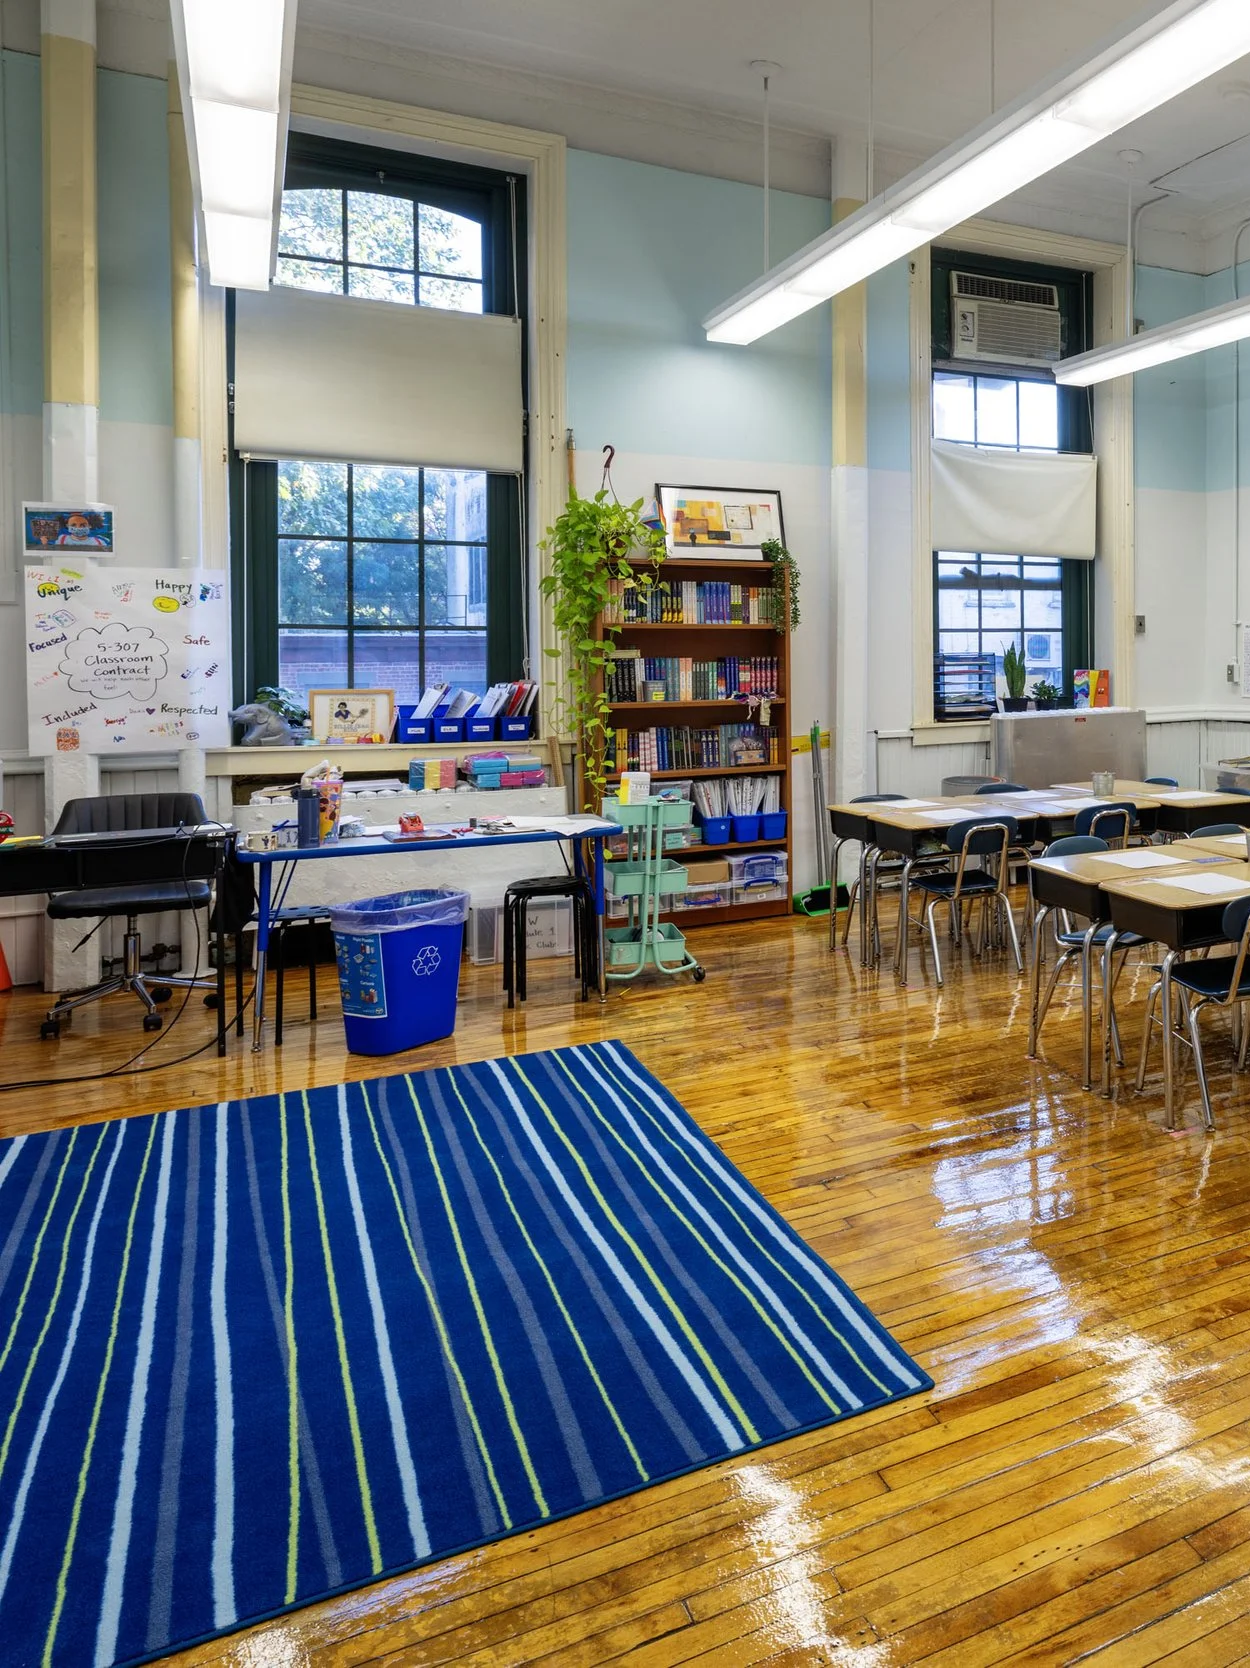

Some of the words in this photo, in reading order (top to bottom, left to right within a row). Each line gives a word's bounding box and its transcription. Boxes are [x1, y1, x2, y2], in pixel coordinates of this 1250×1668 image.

[38, 584, 83, 600] Unique
[156, 580, 192, 594] Happy
[28, 632, 68, 652] Focused
[97, 642, 140, 652] 5-307
[182, 634, 211, 646] Safe
[84, 655, 154, 666] Classroom
[41, 702, 98, 726] Included
[160, 702, 218, 717] Respected
